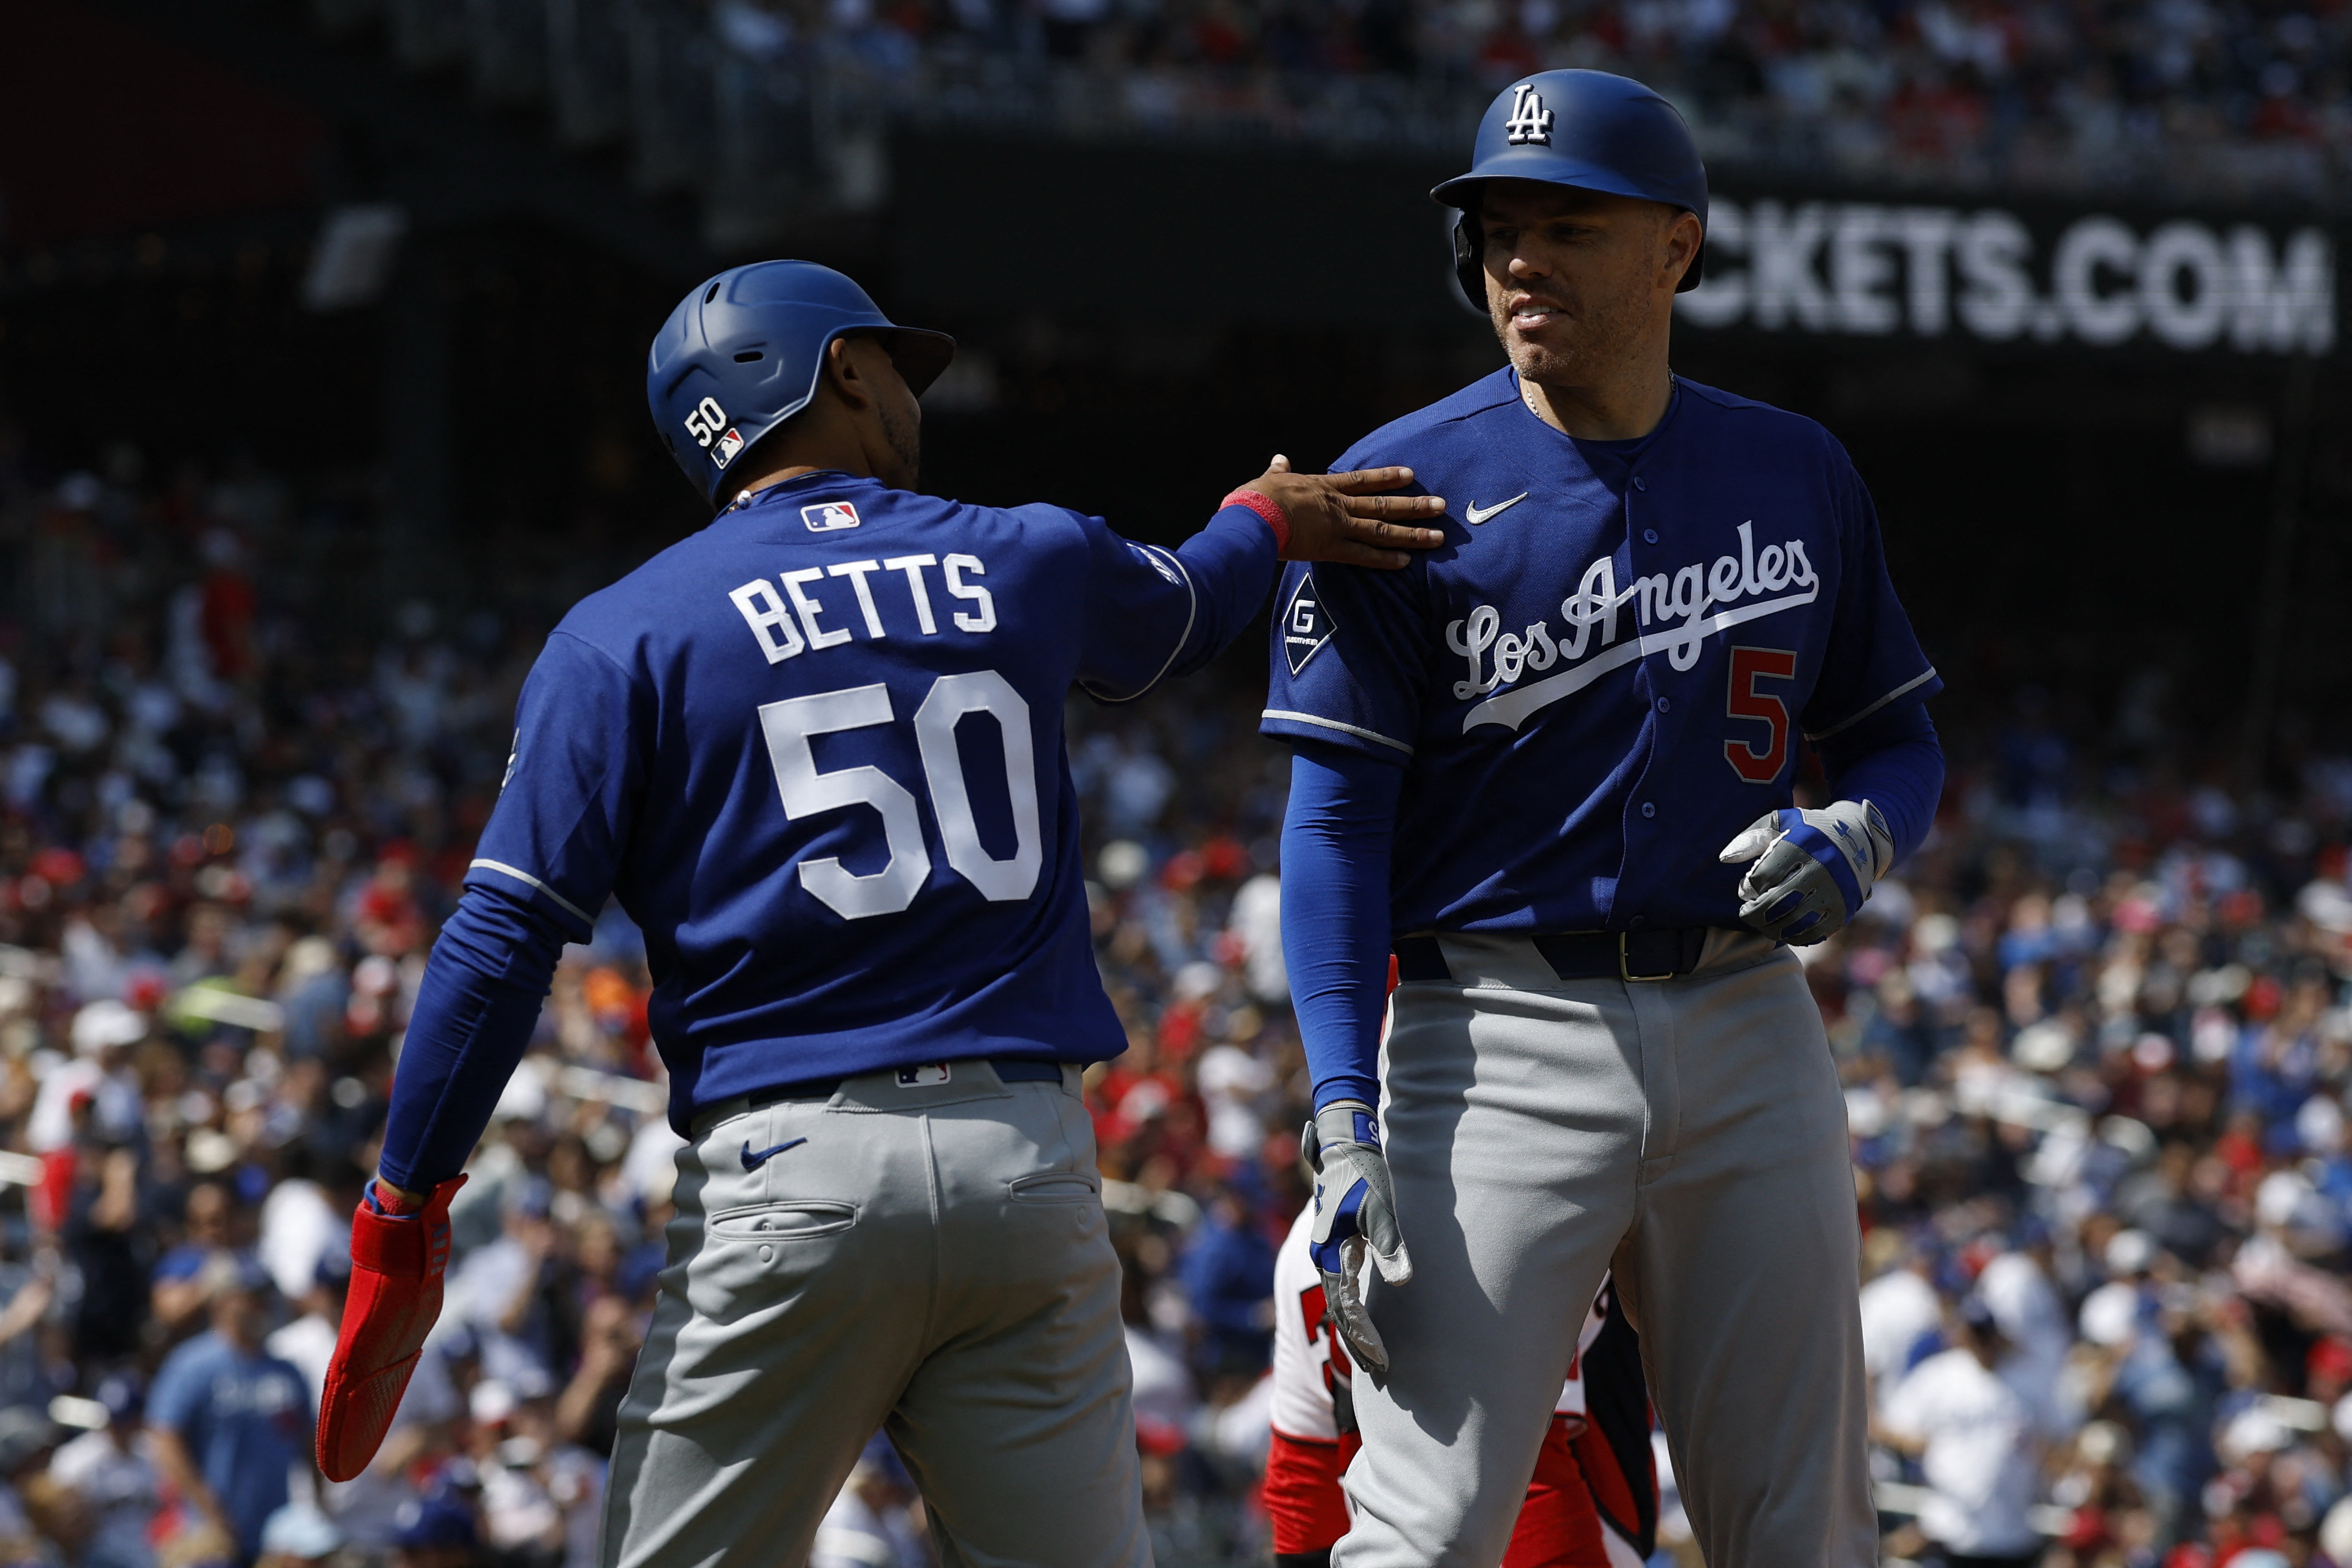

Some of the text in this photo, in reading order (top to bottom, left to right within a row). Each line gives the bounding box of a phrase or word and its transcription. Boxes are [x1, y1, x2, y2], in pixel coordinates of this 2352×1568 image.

[1506, 84, 1551, 142] LA
[684, 396, 727, 447] 50
[728, 553, 997, 665] BETTS
[1292, 599, 1316, 633] G
[1445, 519, 1817, 700] Los Angeles
[1723, 645, 1798, 784] 5
[757, 669, 1043, 921] 50
